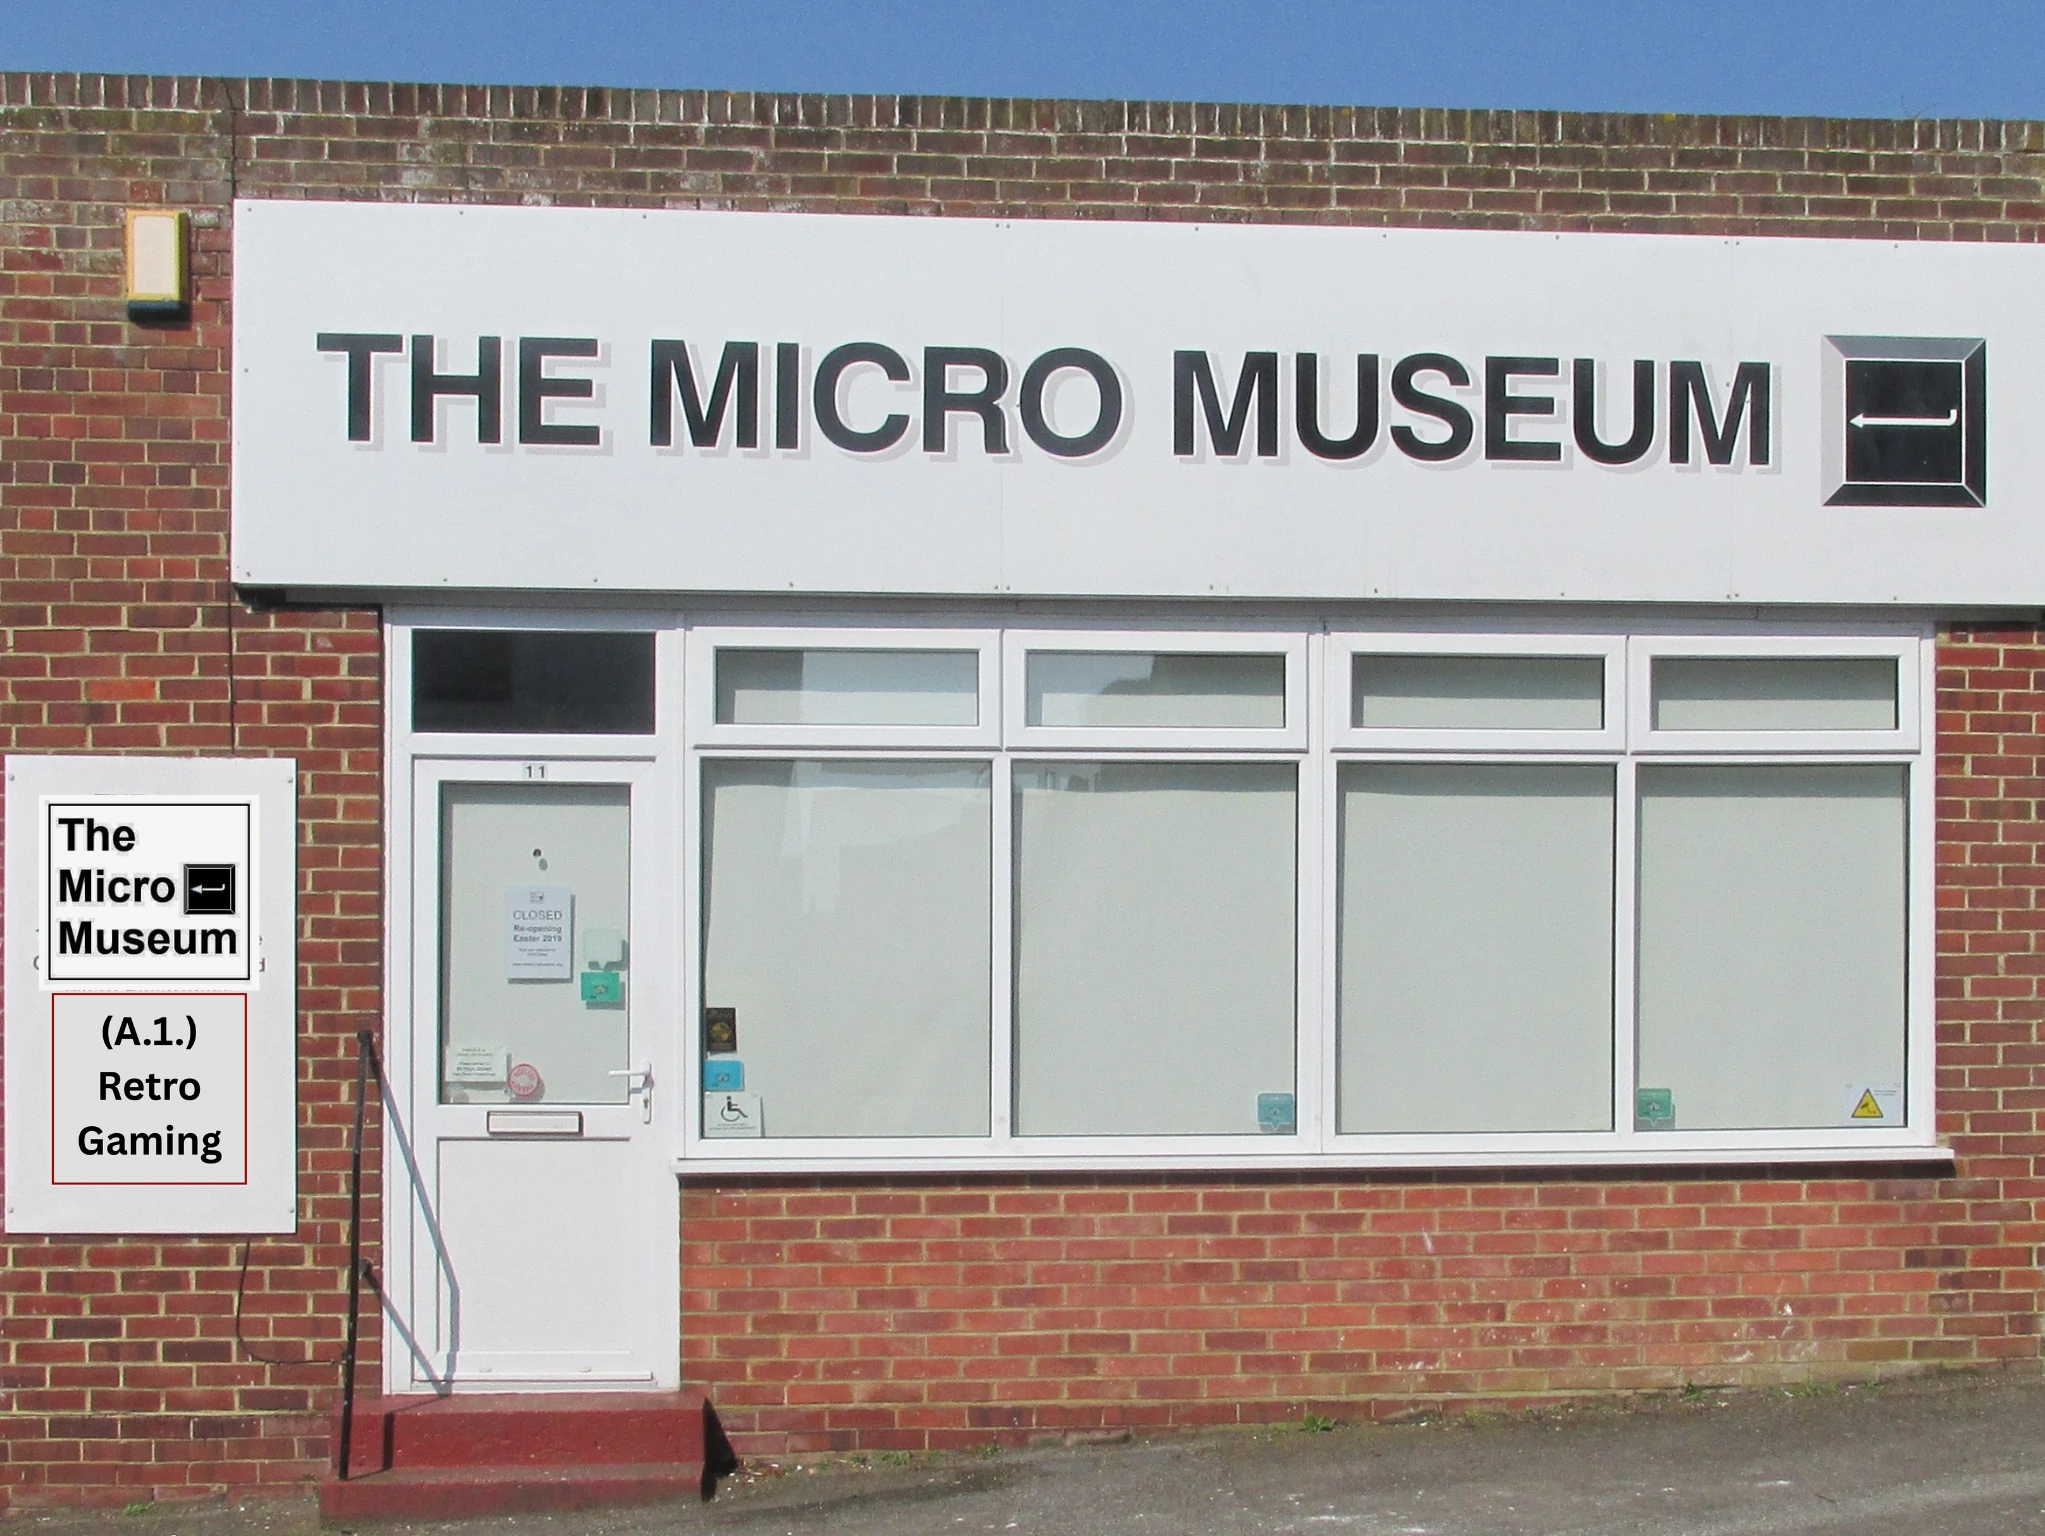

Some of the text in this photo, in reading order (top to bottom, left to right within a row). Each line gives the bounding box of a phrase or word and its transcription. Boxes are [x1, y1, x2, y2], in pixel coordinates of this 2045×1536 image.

[317, 333, 1771, 466] THE MICRO MUSEUM
[526, 765, 545, 779] 11
[513, 910, 563, 920] CLOSED
[513, 925, 562, 934] Re-opening
[513, 935, 563, 943] Easter 2019
